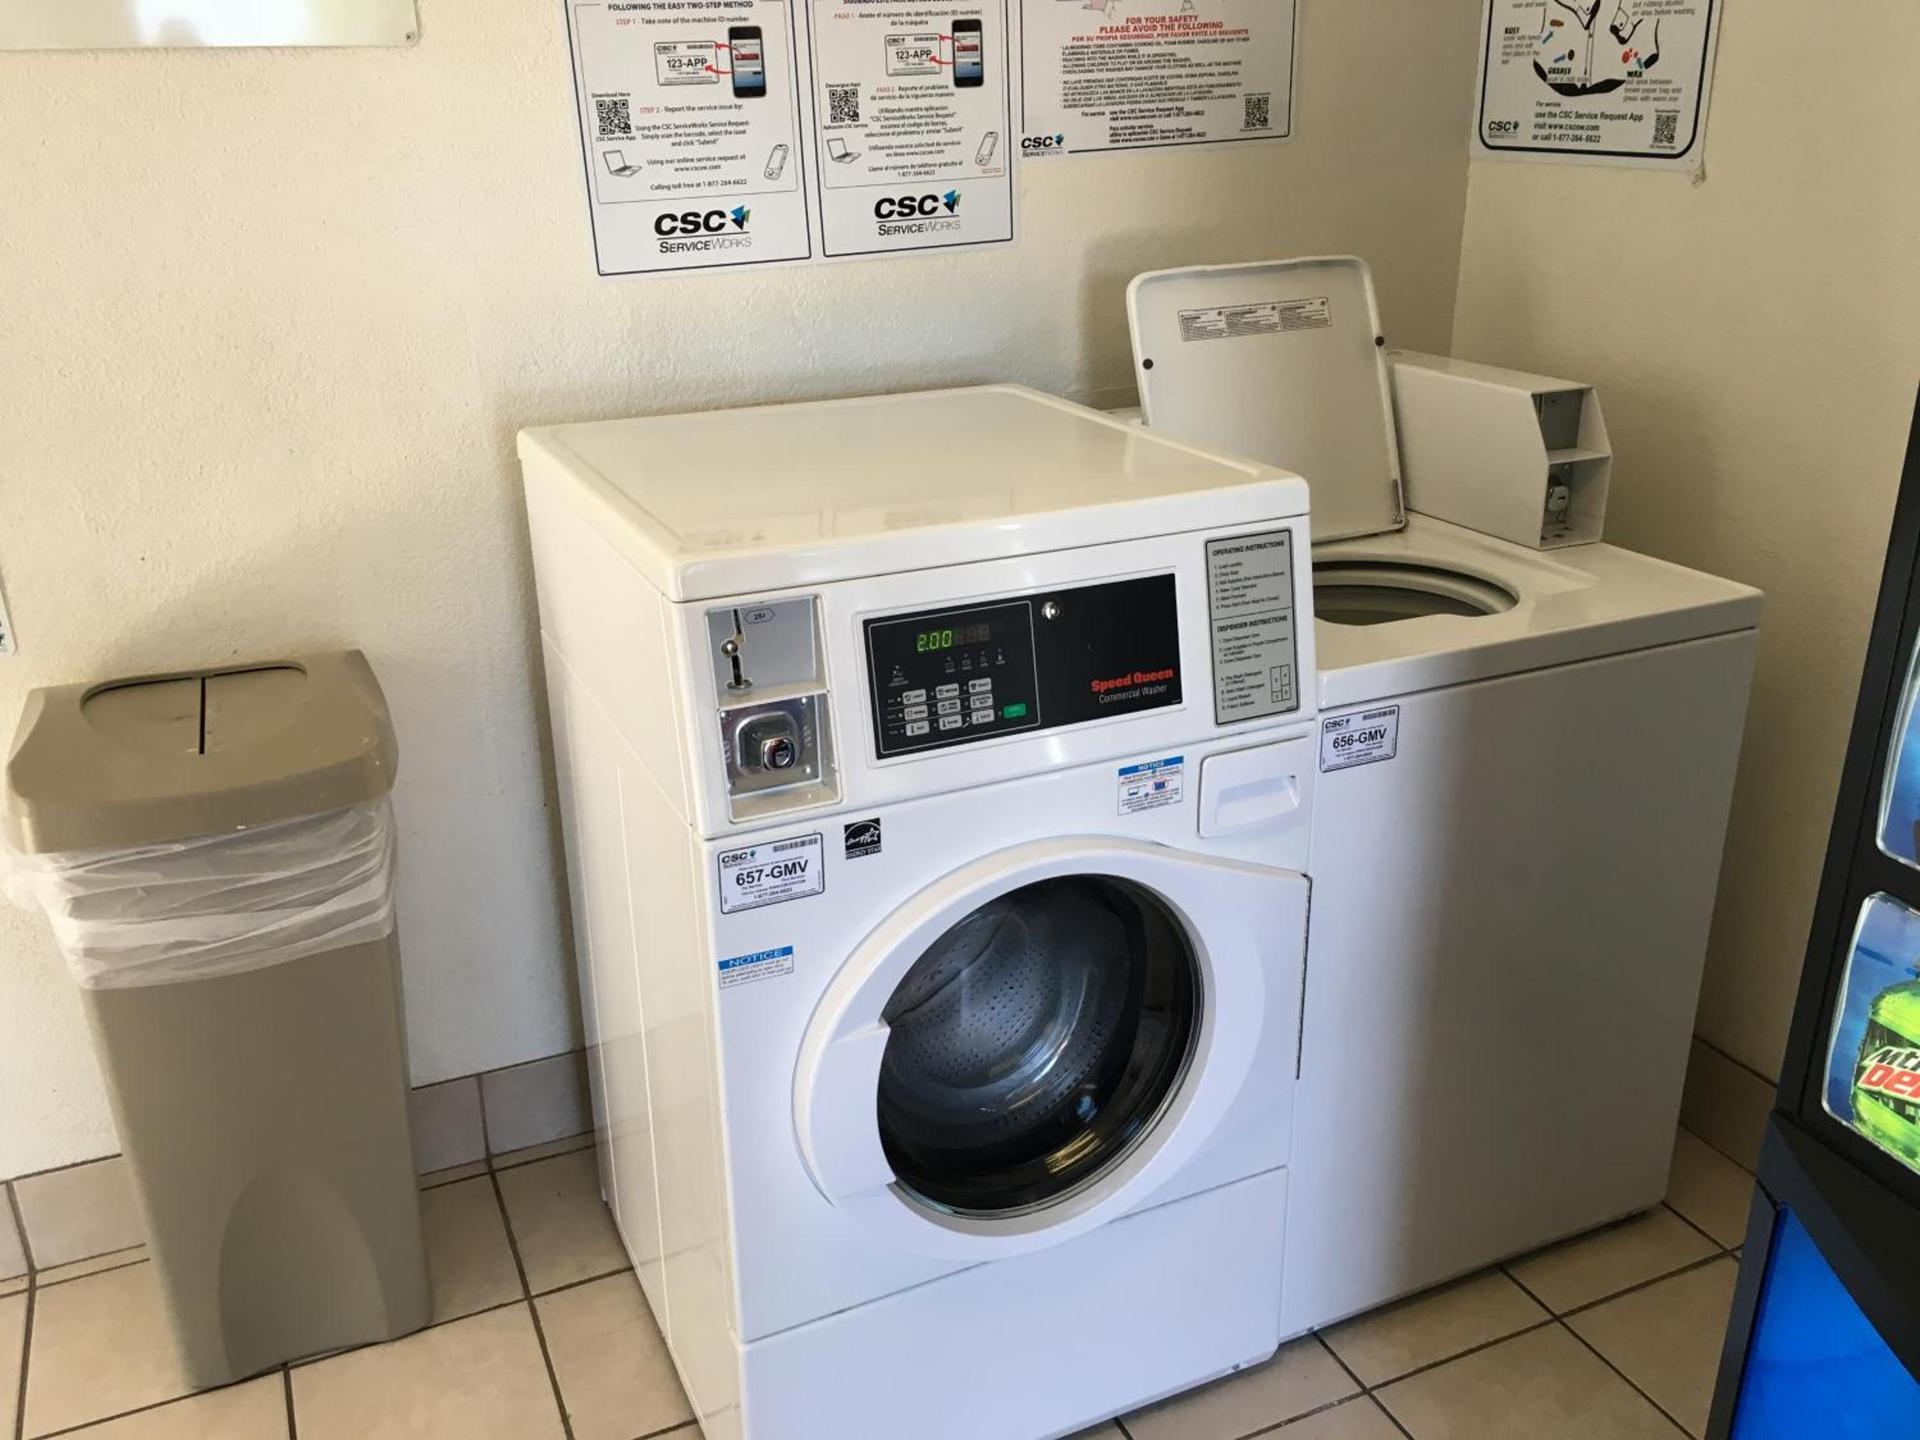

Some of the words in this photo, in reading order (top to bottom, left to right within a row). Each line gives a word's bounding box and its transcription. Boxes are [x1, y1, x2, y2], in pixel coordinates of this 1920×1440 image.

[608, 3, 651, 11] FOLLOWING
[616, 18, 630, 26] STEP
[1144, 16, 1167, 24] YOUR
[1168, 15, 1198, 23] SAFETY
[1099, 25, 1130, 33] PLEASE
[1132, 24, 1157, 32] AVOID
[1160, 23, 1175, 31] THE
[1178, 21, 1223, 30] FOLLOWING
[896, 49, 932, 60] 123-APP
[667, 57, 708, 68] 123-APP
[1627, 70, 1643, 78] WAX
[664, 105, 685, 113] Report
[1559, 111, 1572, 119] CSC
[1574, 111, 1598, 119] Service
[1600, 111, 1627, 121] Request
[1629, 112, 1644, 122] App
[1488, 120, 1511, 131] CSC
[1021, 136, 1053, 148] CSC
[1540, 133, 1552, 141] call
[717, 154, 739, 162] request
[650, 183, 671, 191] Calling
[874, 194, 939, 219] CSC
[654, 209, 726, 236] CSC
[1212, 545, 1244, 556] OPERATING
[1245, 540, 1284, 552] INSTRUCTIONS
[1216, 620, 1248, 633] DISPENSER
[1249, 614, 1288, 627] INSTRUCTIONS
[917, 630, 952, 652] 2.00
[1091, 674, 1132, 692] Speed
[1134, 668, 1174, 684] Queen
[1098, 688, 1140, 703] Commercial
[1141, 684, 1167, 696] Washer
[1325, 719, 1344, 729] CSC
[1333, 728, 1387, 749] 656-GMV
[1138, 760, 1166, 770] NOTICE
[721, 852, 748, 864] CSC
[736, 859, 808, 886] 657-GMV
[729, 949, 783, 966] NOTICE
